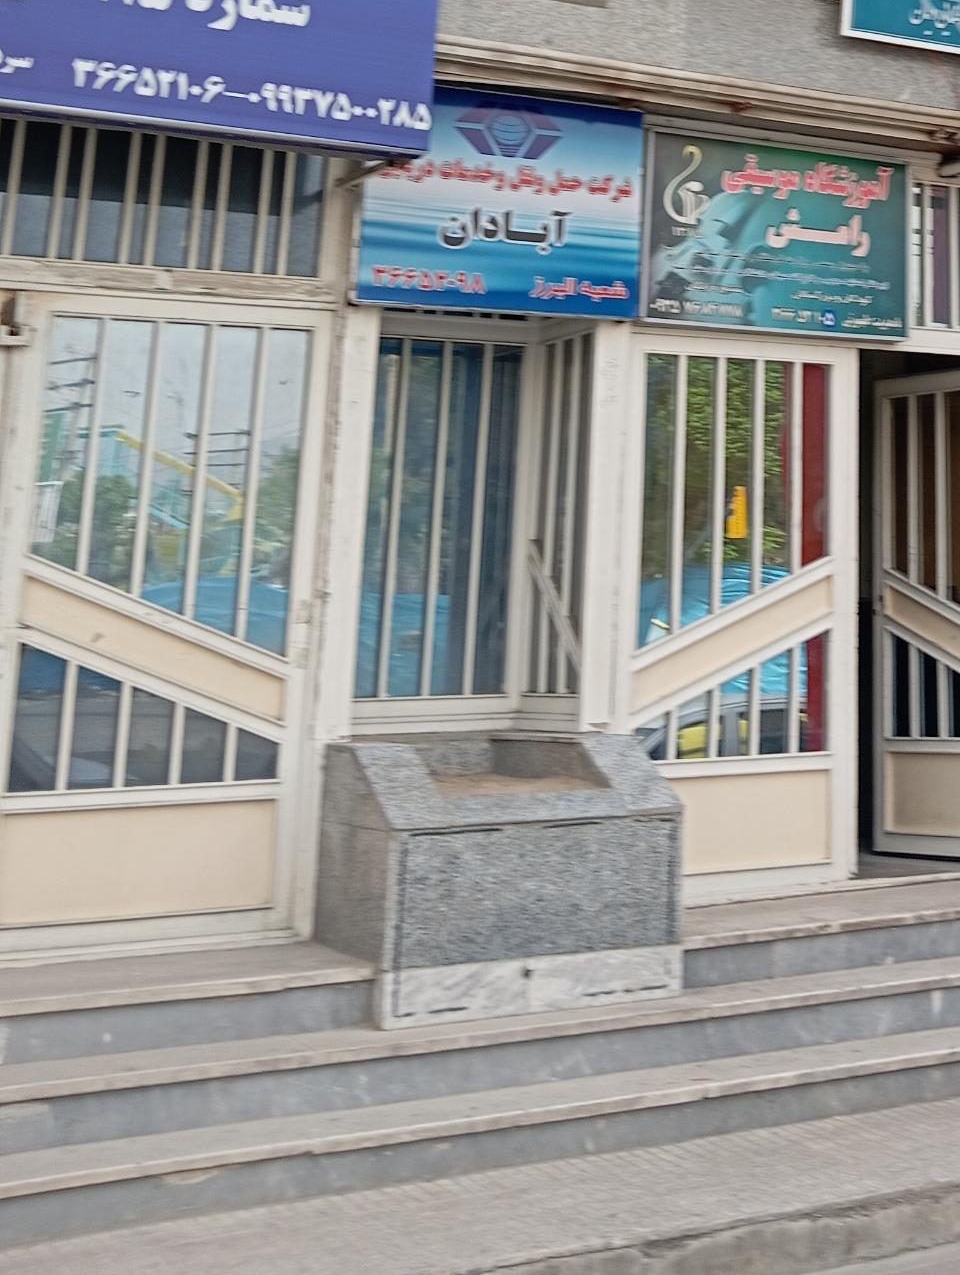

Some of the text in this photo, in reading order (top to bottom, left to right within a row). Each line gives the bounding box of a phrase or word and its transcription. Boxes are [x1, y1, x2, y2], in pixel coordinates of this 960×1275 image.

[721, 153, 895, 209] آموزشگاه موسیقی
[438, 208, 571, 254] آبادان
[529, 275, 578, 299] البرز
